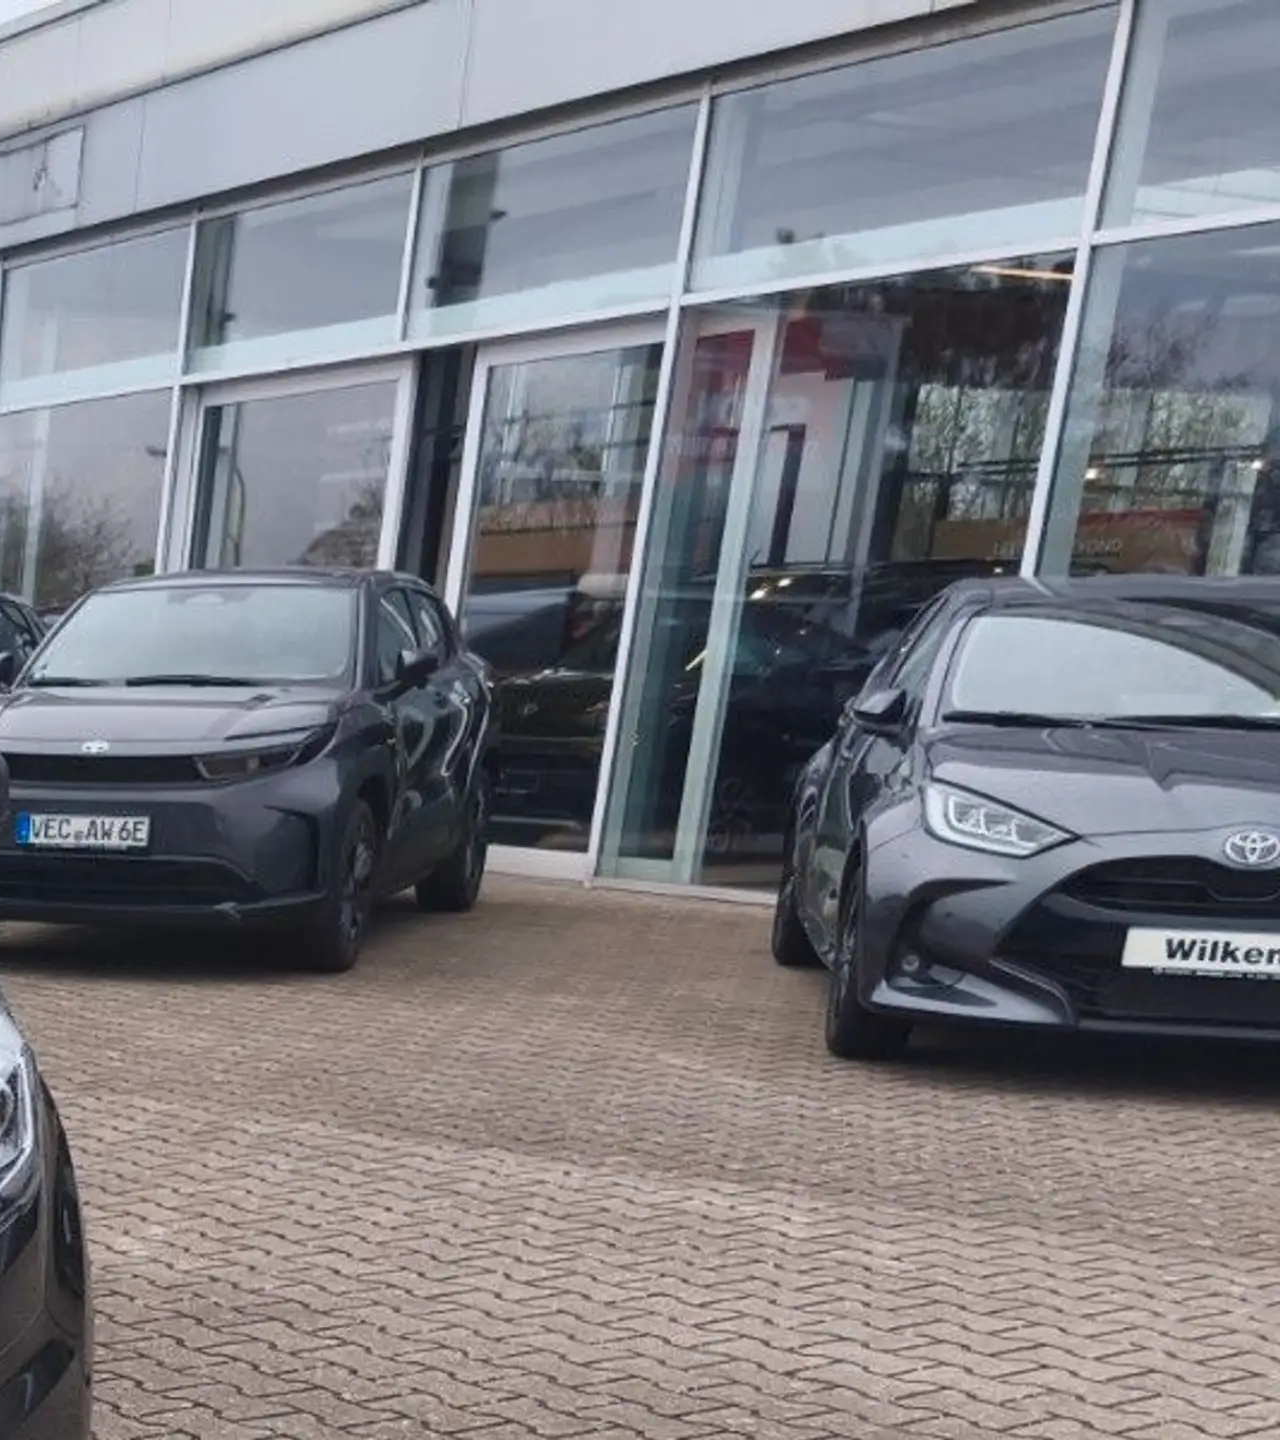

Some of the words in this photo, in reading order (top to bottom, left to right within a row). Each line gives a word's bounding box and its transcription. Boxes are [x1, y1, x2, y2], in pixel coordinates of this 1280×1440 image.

[32, 818, 71, 840] VEC
[86, 819, 114, 841] AW
[118, 820, 146, 842] 6E
